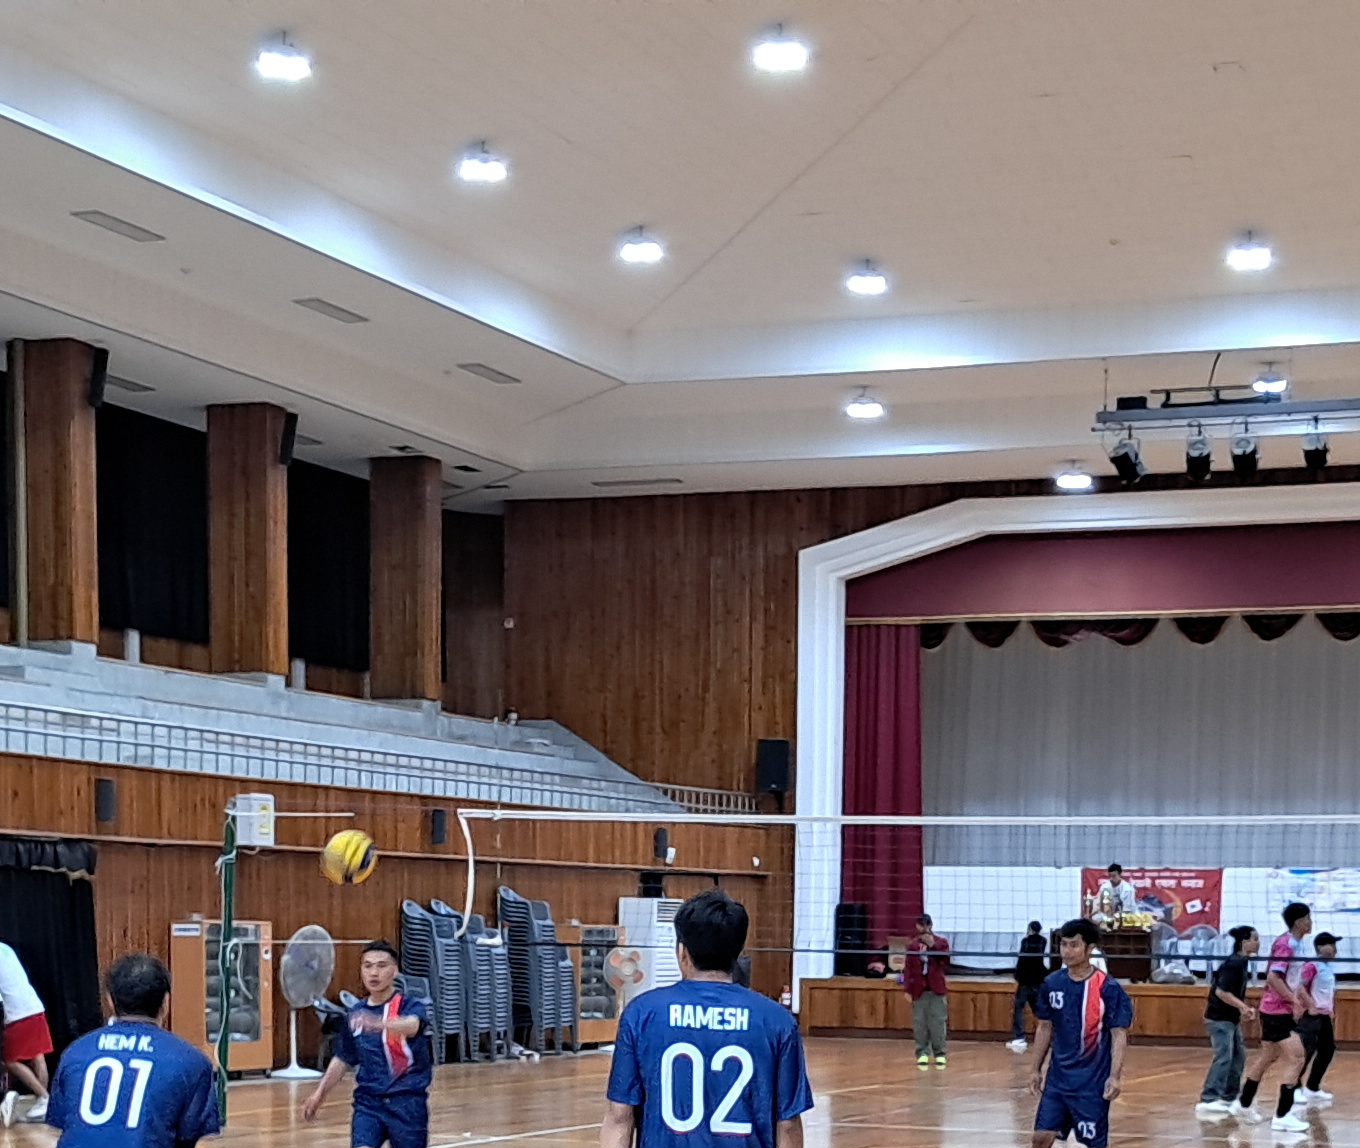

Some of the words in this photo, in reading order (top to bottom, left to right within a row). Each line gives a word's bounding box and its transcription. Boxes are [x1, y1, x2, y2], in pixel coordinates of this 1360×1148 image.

[98, 1033, 137, 1051] HEM
[669, 1004, 749, 1031] RAMESH
[80, 1057, 154, 1129] 01
[661, 1042, 754, 1136] 02
